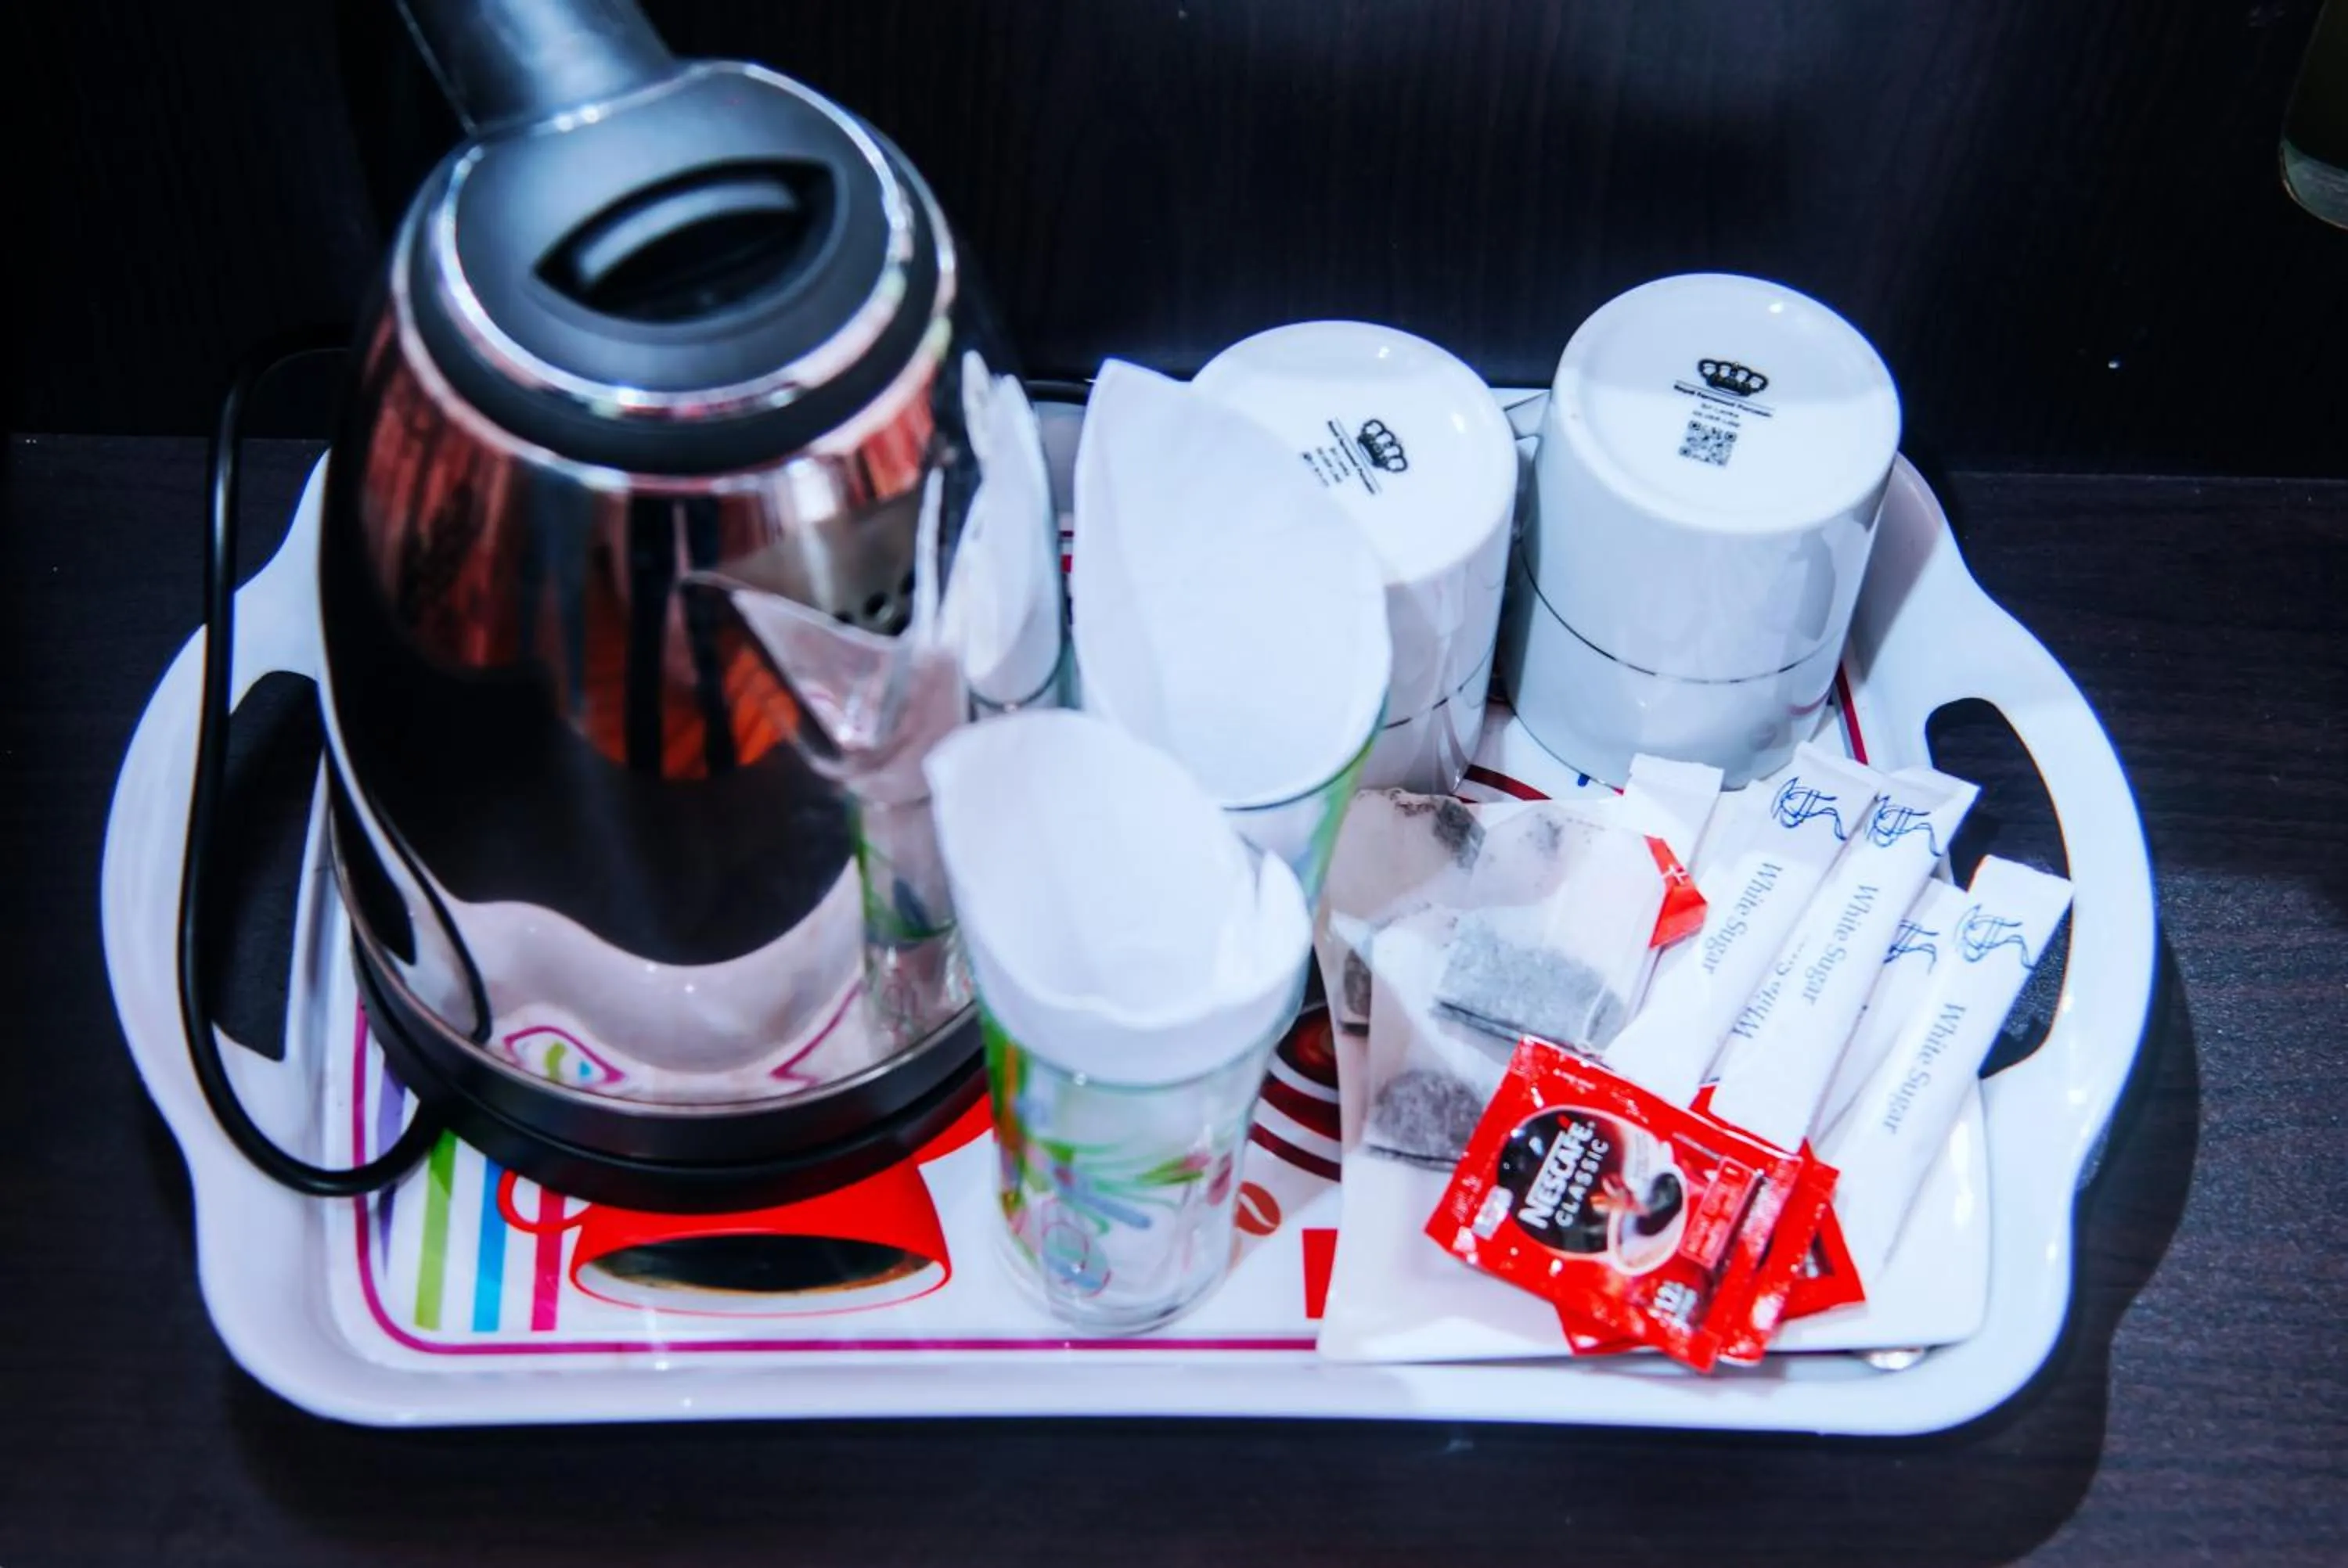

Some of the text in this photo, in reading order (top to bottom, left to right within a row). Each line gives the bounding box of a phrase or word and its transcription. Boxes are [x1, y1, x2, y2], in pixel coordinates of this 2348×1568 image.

[1702, 861, 1784, 975] White Sugar
[1802, 884, 1879, 1006] White Sugar
[1882, 1002, 1967, 1135] White Sugar
[1554, 1138, 1609, 1227] CLASSIC
